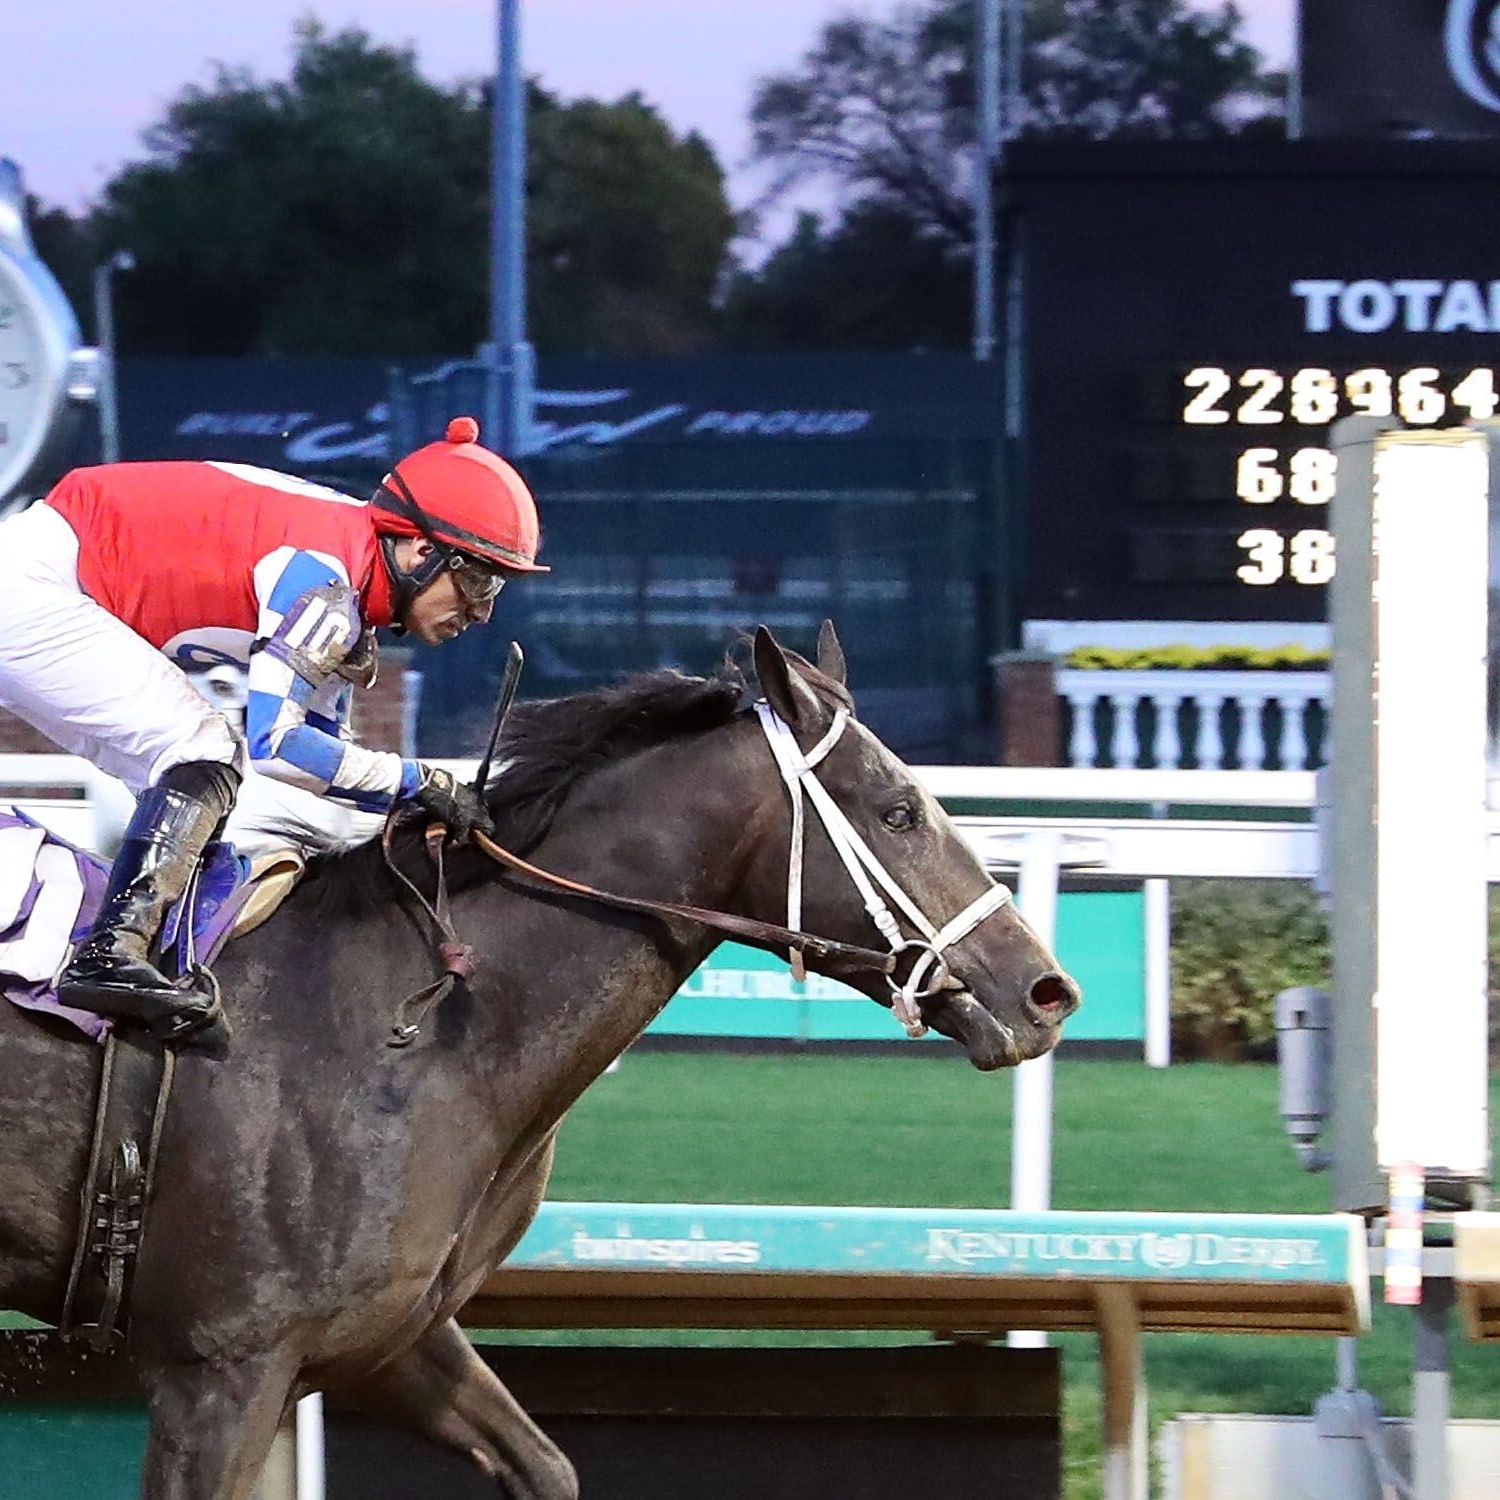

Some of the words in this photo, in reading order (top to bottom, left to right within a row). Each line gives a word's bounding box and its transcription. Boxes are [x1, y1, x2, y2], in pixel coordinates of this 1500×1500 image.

[1290, 277, 1500, 333] TOTA
[1236, 447, 1338, 505] 68
[1236, 528, 1337, 586] 38
[925, 1228, 1142, 1266] KENTUCKY
[1192, 1232, 1326, 1270] DERBY
